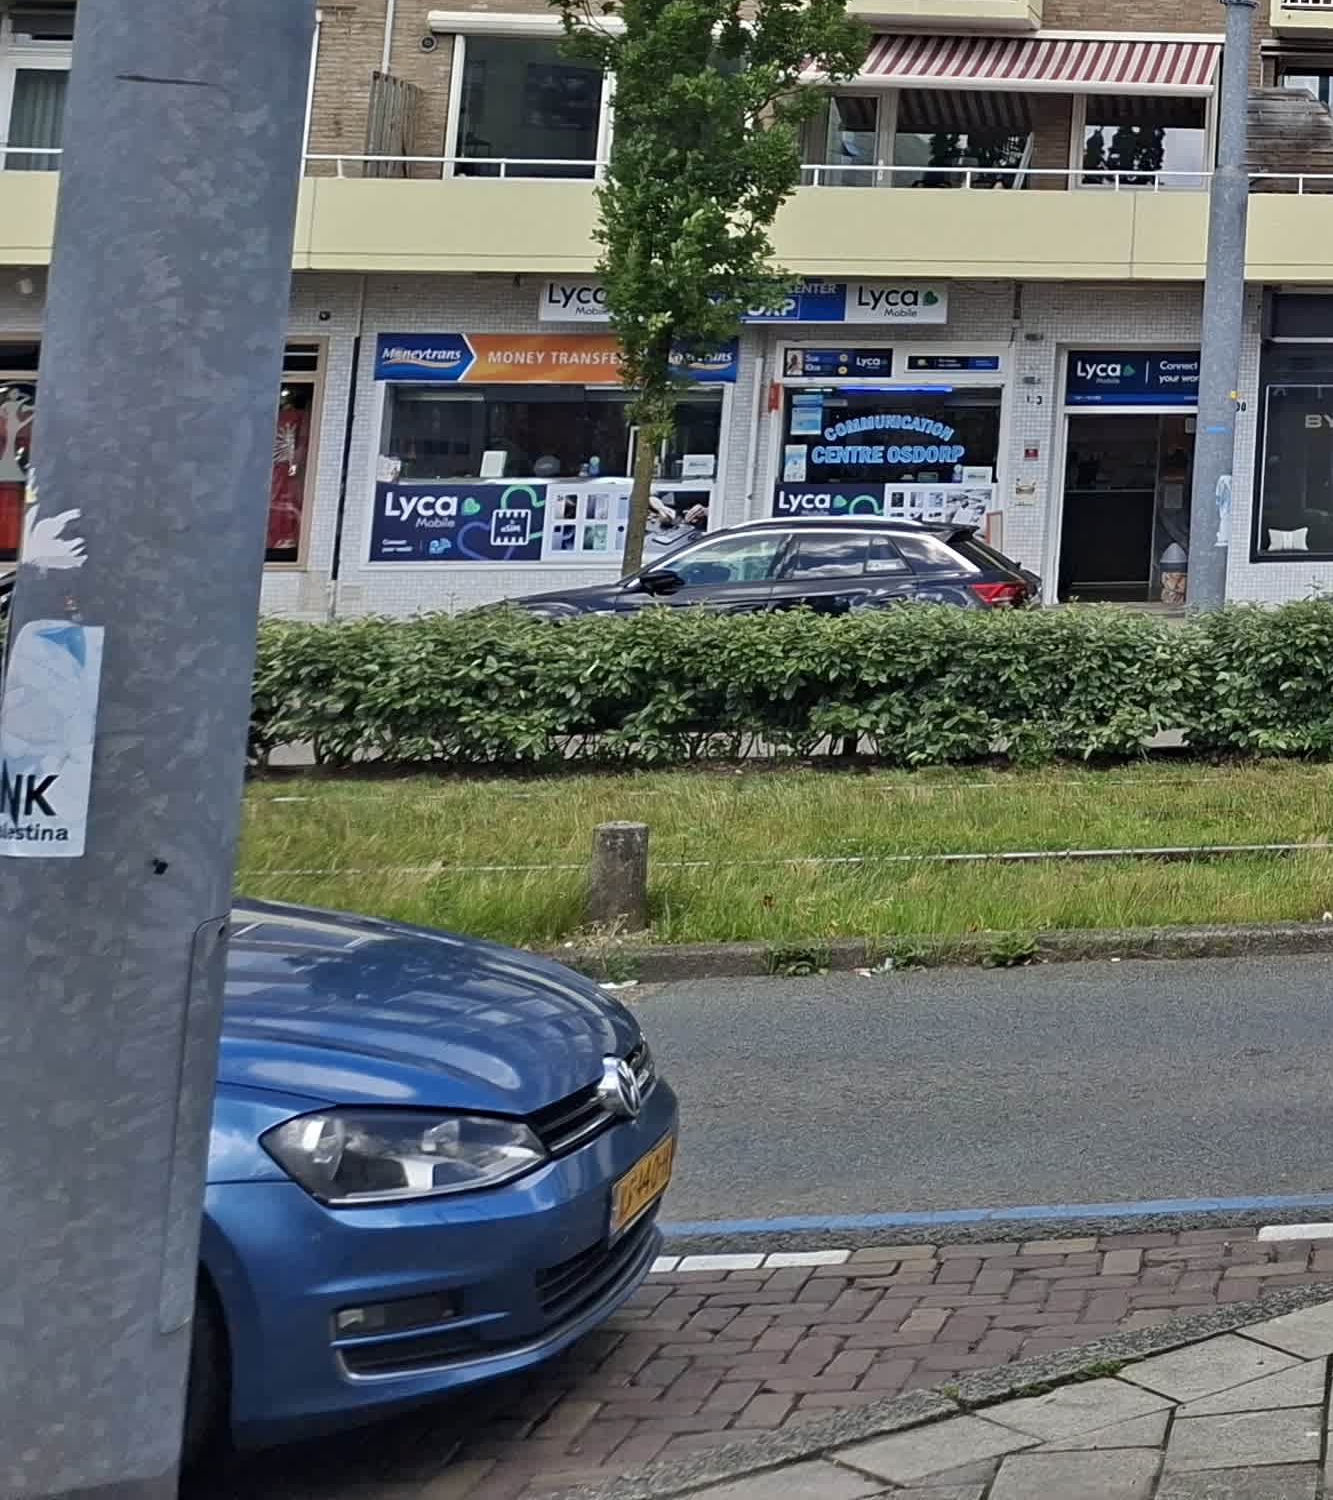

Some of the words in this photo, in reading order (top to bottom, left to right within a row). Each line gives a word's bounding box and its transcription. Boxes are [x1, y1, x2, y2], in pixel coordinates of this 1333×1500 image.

[857, 285, 919, 311] Lyca
[883, 307, 918, 318] Mobile
[381, 346, 462, 362] Moneytrans
[487, 351, 545, 365] MONEY
[550, 351, 625, 366] TRANSFE
[856, 356, 881, 370] Lyca
[1076, 360, 1121, 380] Lyca
[1182, 374, 1200, 384] wor
[823, 414, 956, 442] COMMUNICATION
[811, 445, 885, 465] CENTRE
[886, 445, 966, 465] OSDORP
[384, 491, 459, 522] Lyca
[778, 490, 831, 513] Lyca
[415, 517, 456, 529] Mobile
